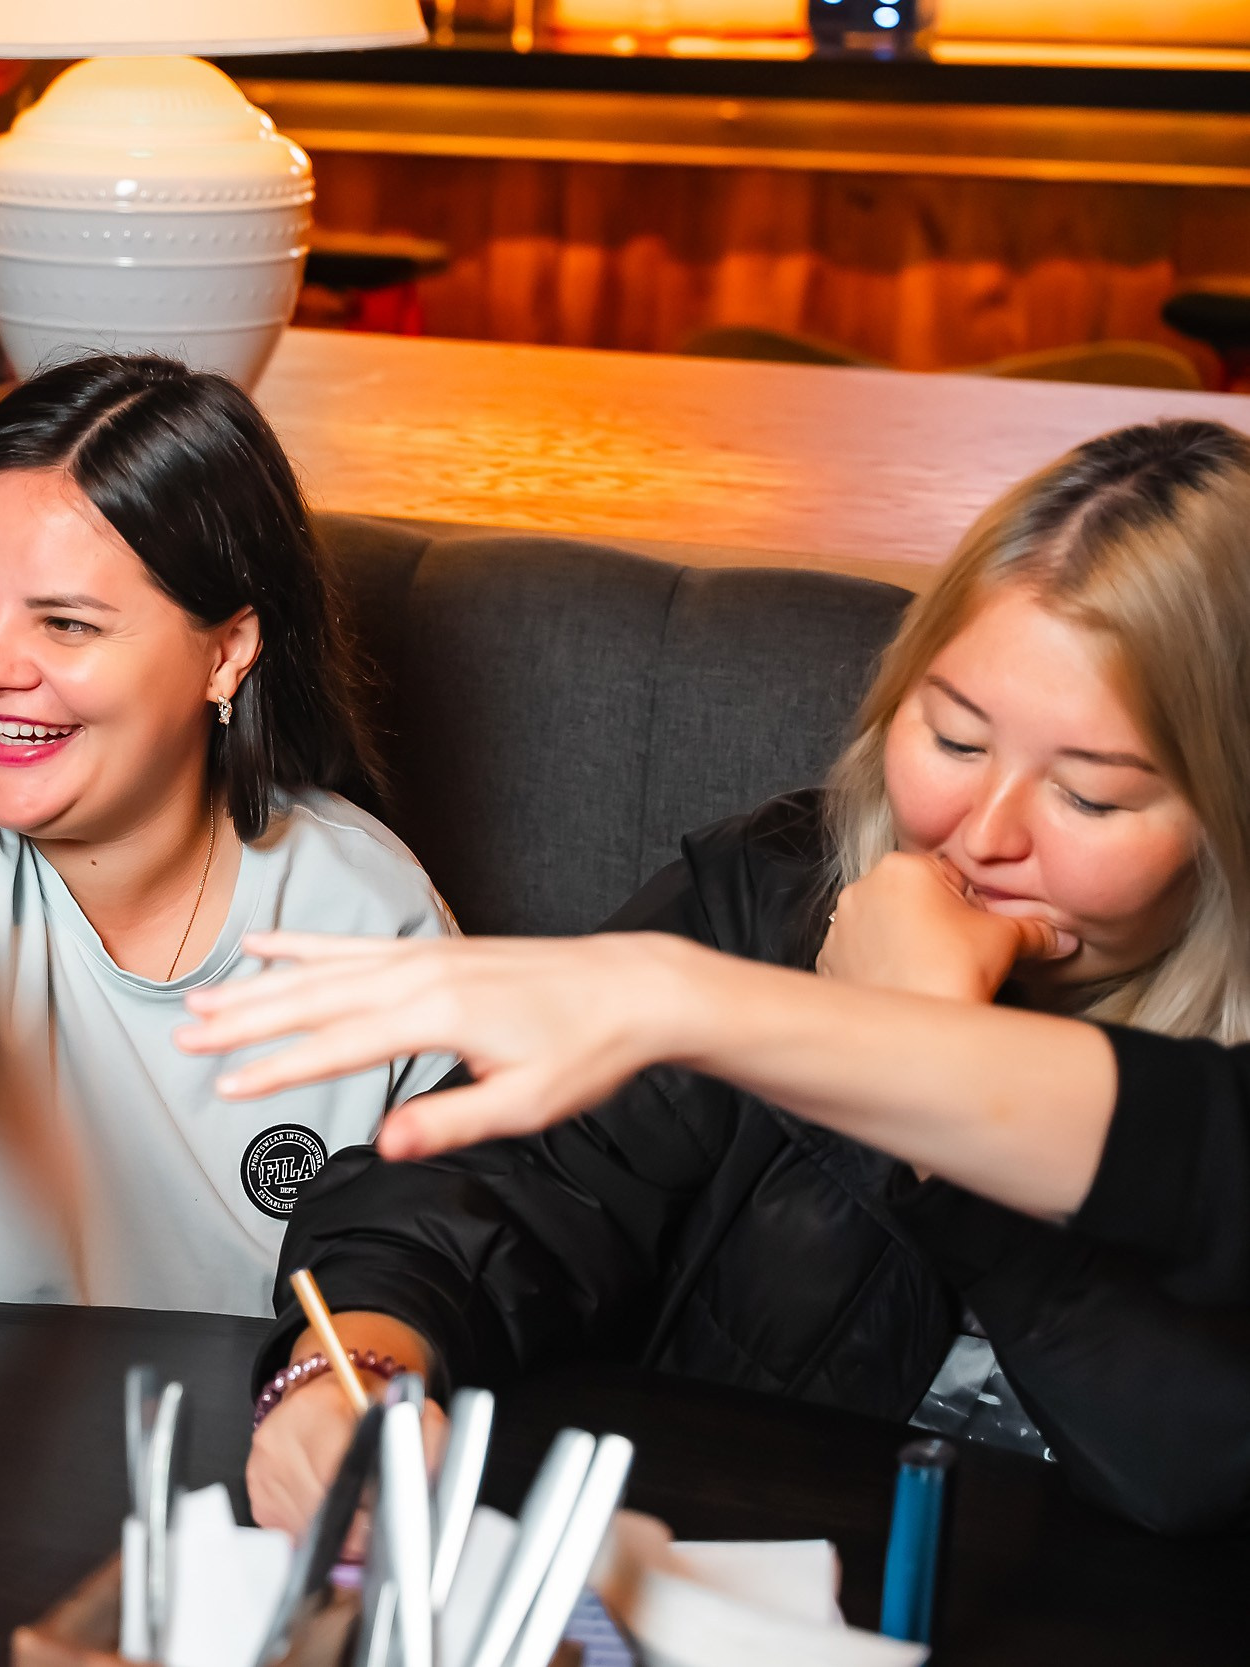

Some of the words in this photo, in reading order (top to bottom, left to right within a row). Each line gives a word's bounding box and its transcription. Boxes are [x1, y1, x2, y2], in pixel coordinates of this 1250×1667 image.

[251, 1133, 284, 1171] SPORTSWEAR
[286, 1133, 323, 1173] INTERNATIONA
[259, 1153, 316, 1187] FILA
[257, 1189, 296, 1210] ESTABLISH
[279, 1186, 298, 1194] DEPT.
